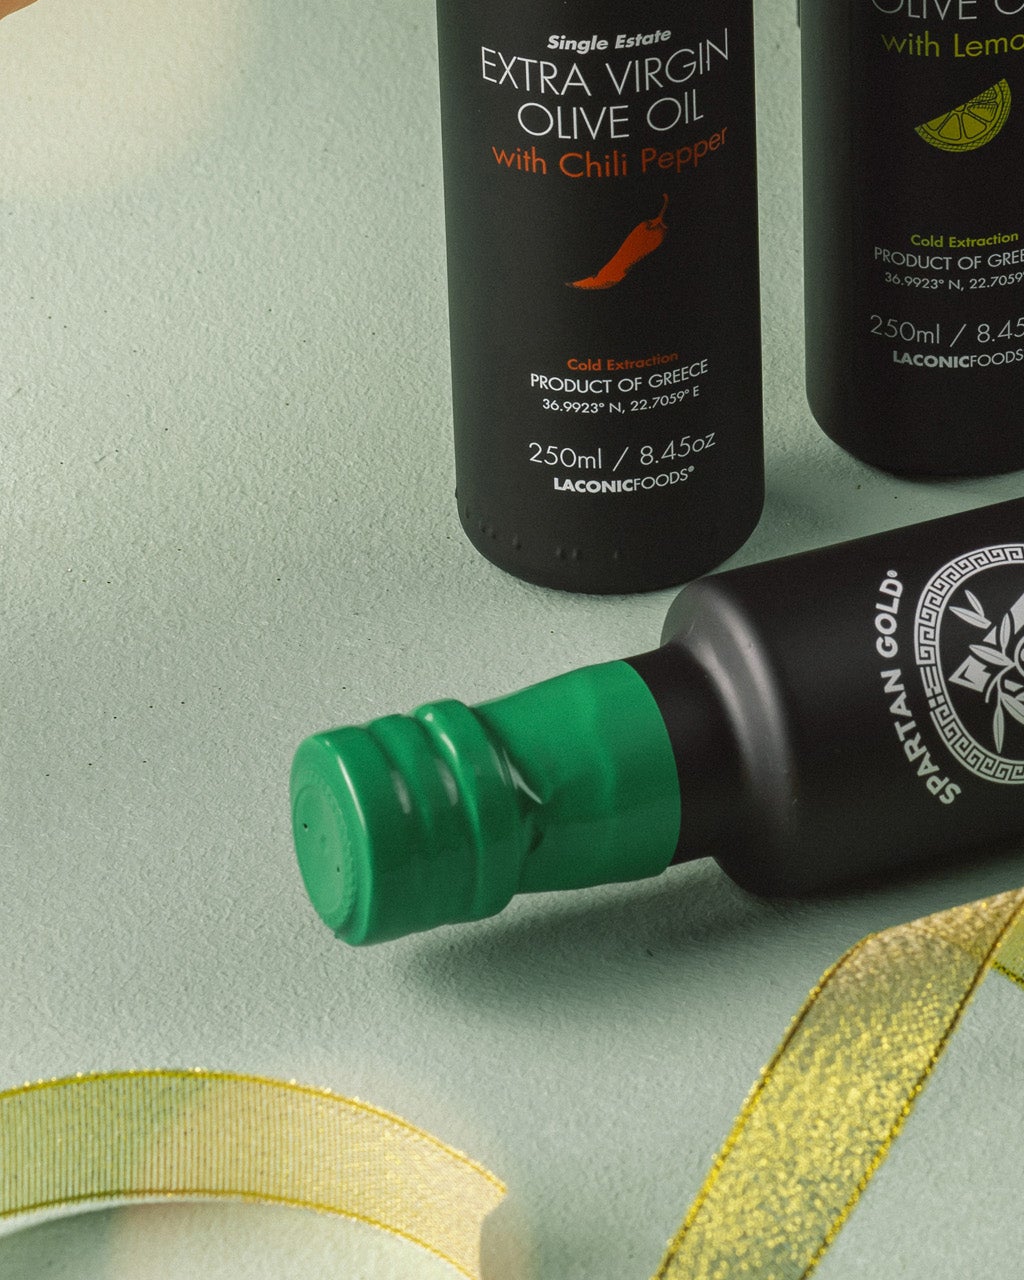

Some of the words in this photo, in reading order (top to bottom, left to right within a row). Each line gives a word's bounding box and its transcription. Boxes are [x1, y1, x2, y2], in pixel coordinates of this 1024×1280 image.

[547, 34, 609, 55] Single
[614, 29, 672, 50] Estate
[881, 30, 940, 57] with
[481, 46, 592, 97] EXTRA
[605, 27, 729, 96] VIRGIN
[517, 102, 630, 141] OLIVE
[646, 89, 704, 132] OIL
[491, 145, 547, 175] with
[558, 150, 628, 179] Chili
[641, 126, 728, 174] Pepper
[910, 234, 944, 248] Cold
[948, 232, 1019, 248] Extraction
[874, 246, 952, 271] PRODUCT
[957, 255, 982, 270] OF
[948, 280, 964, 292] N,
[870, 314, 940, 344] 250ml
[949, 323, 967, 348] /
[530, 372, 612, 394] PRODUCT
[617, 376, 642, 393] OF
[648, 358, 709, 389] GREECE
[567, 358, 601, 371] Cold
[607, 352, 679, 371] Extraction
[609, 401, 625, 415] N,
[692, 385, 700, 397] E
[528, 442, 602, 470] 250ml
[612, 446, 629, 472] /
[640, 432, 716, 466] 8.45oz
[880, 668, 962, 805] SPARTAN
